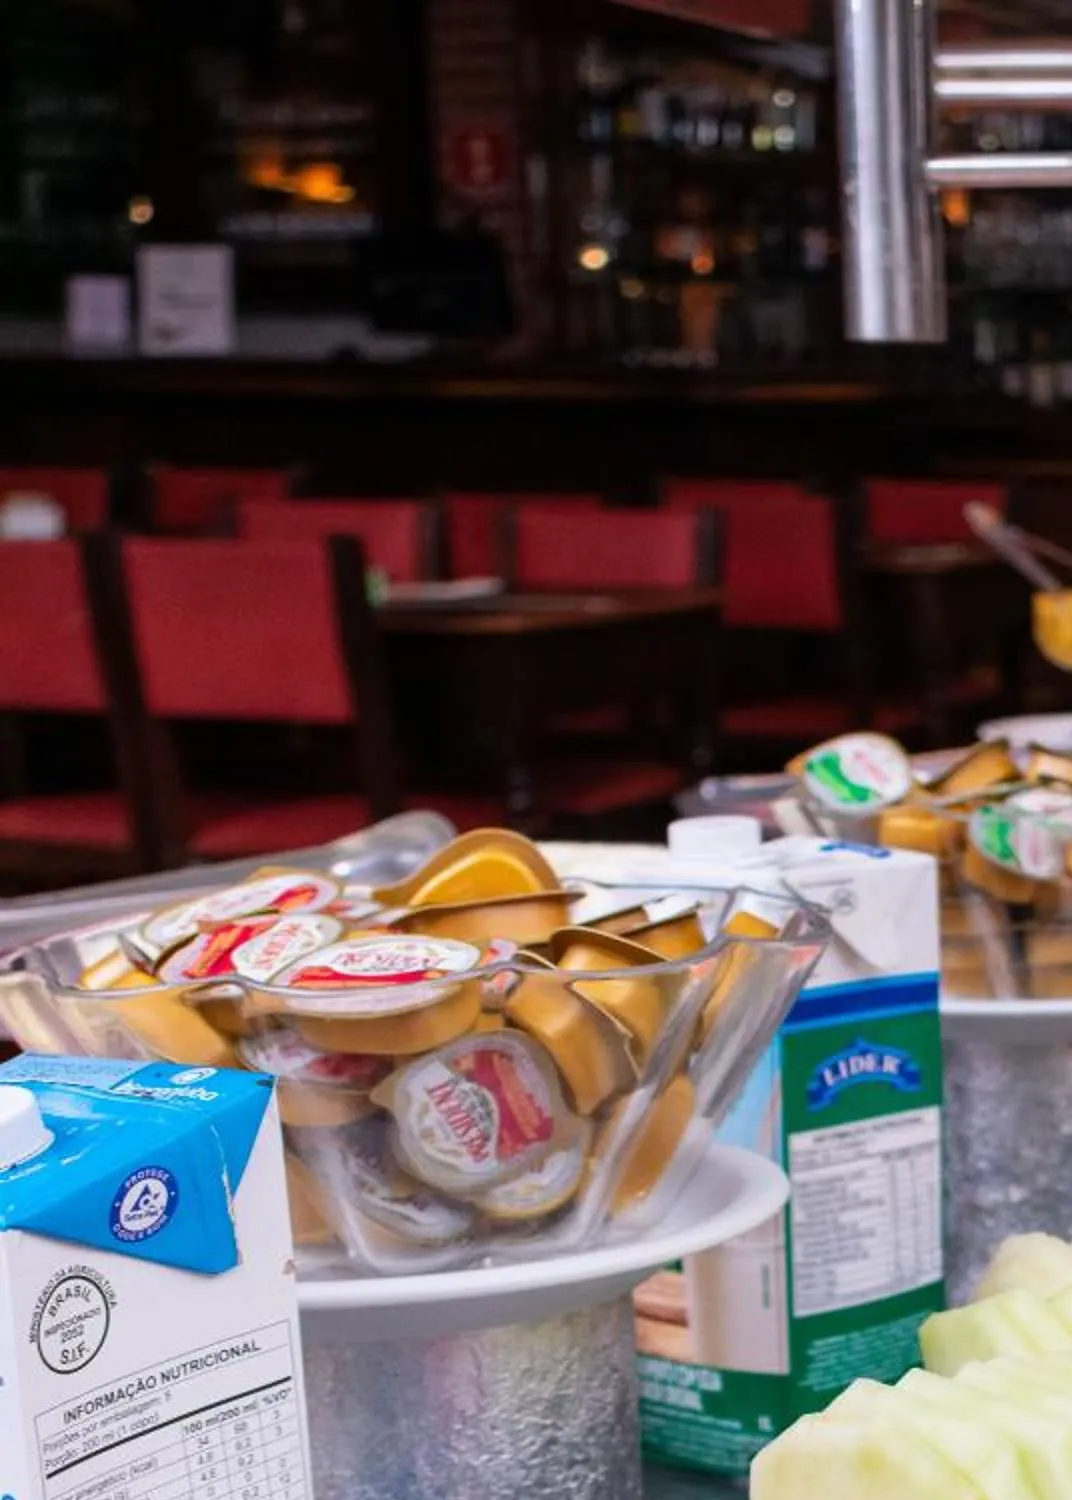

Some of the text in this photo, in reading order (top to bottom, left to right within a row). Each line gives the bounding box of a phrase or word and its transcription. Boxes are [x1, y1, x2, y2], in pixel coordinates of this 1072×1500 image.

[48, 1285, 92, 1317] BRASIL
[63, 1338, 261, 1422] INFORMAÇÃO NUTRICIONAL
[184, 1420, 203, 1433] 100
[220, 1406, 239, 1422] 200
